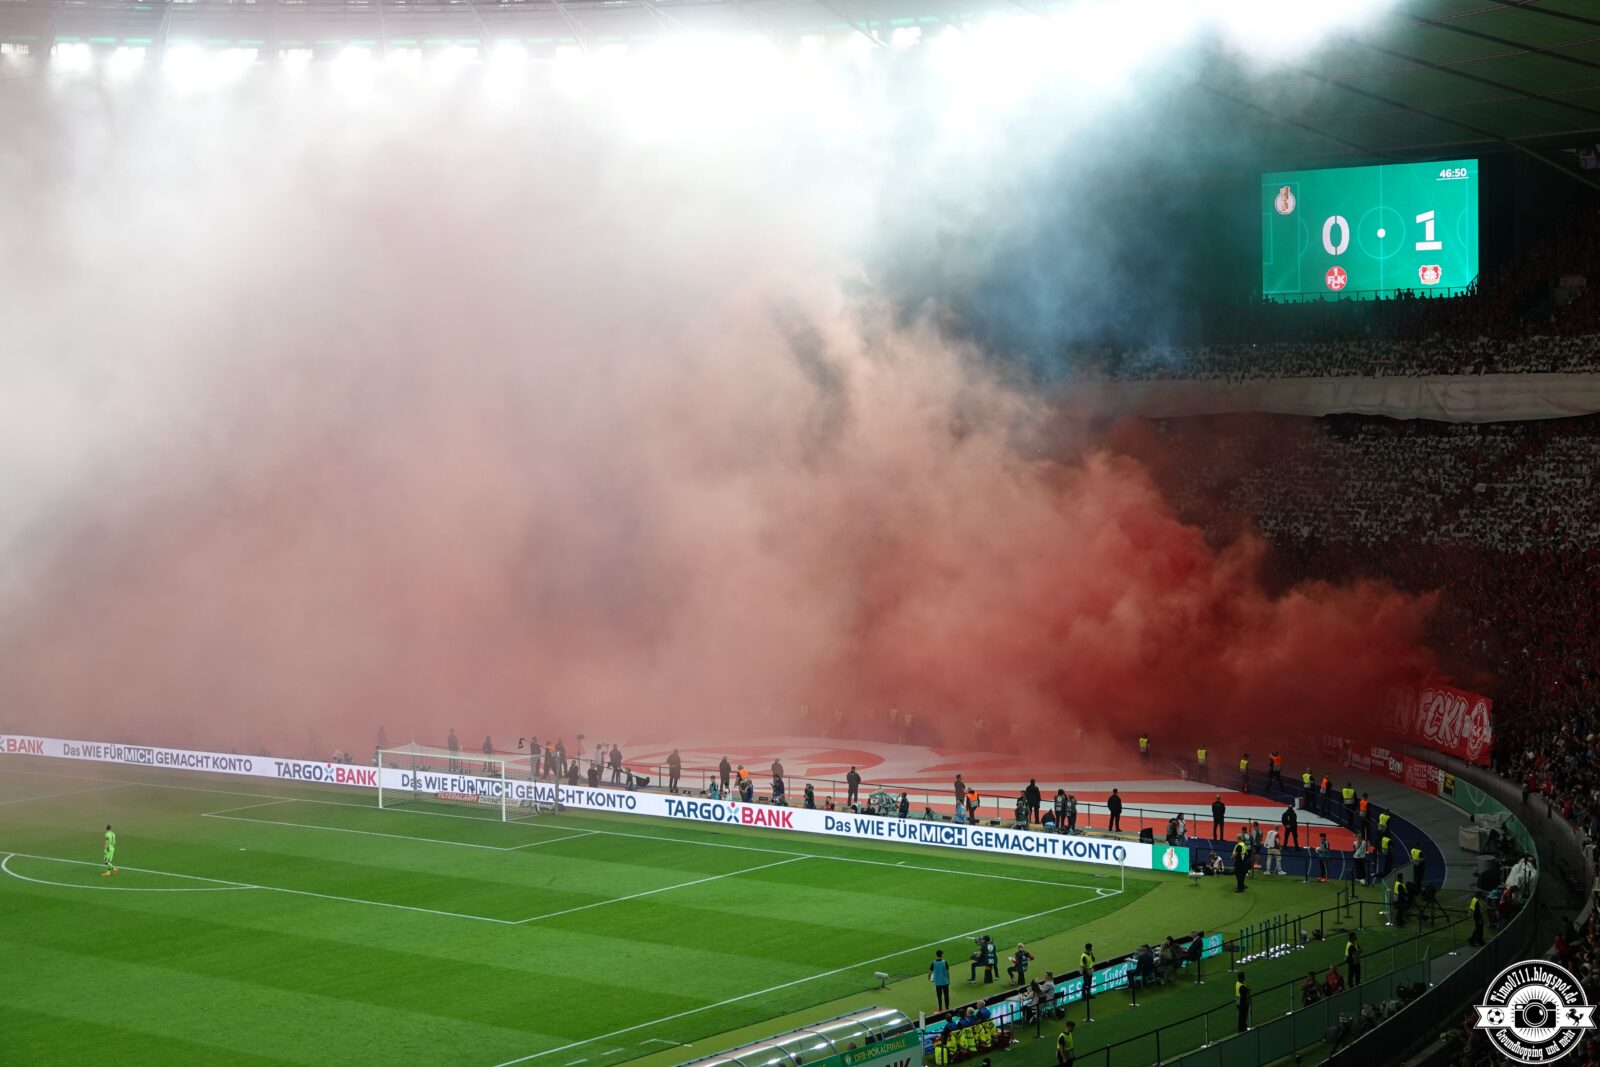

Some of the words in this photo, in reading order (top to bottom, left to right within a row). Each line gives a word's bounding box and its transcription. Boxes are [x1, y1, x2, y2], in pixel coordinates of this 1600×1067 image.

[1440, 168, 1467, 178] 46:50
[1322, 215, 1350, 256] 0
[1415, 210, 1442, 251] 1
[6, 738, 44, 755] BANK
[63, 743, 81, 757] Das
[82, 745, 102, 758] WIE
[103, 744, 124, 761] FÜR
[125, 747, 153, 763] MICH
[156, 752, 210, 769] GEMACHT
[212, 756, 253, 772] KONTO
[401, 774, 423, 790] Das
[424, 776, 448, 791] WIE
[450, 776, 475, 793] FÜR
[476, 780, 513, 798] MICH
[516, 785, 584, 804] GEMACHT
[586, 791, 637, 810] KONTO
[825, 816, 851, 832] Das
[855, 819, 884, 836] WIE
[888, 820, 917, 840] FÜR
[921, 825, 966, 846] MICH
[971, 831, 1059, 855] GEMACHT
[1062, 840, 1127, 862] KONTO
